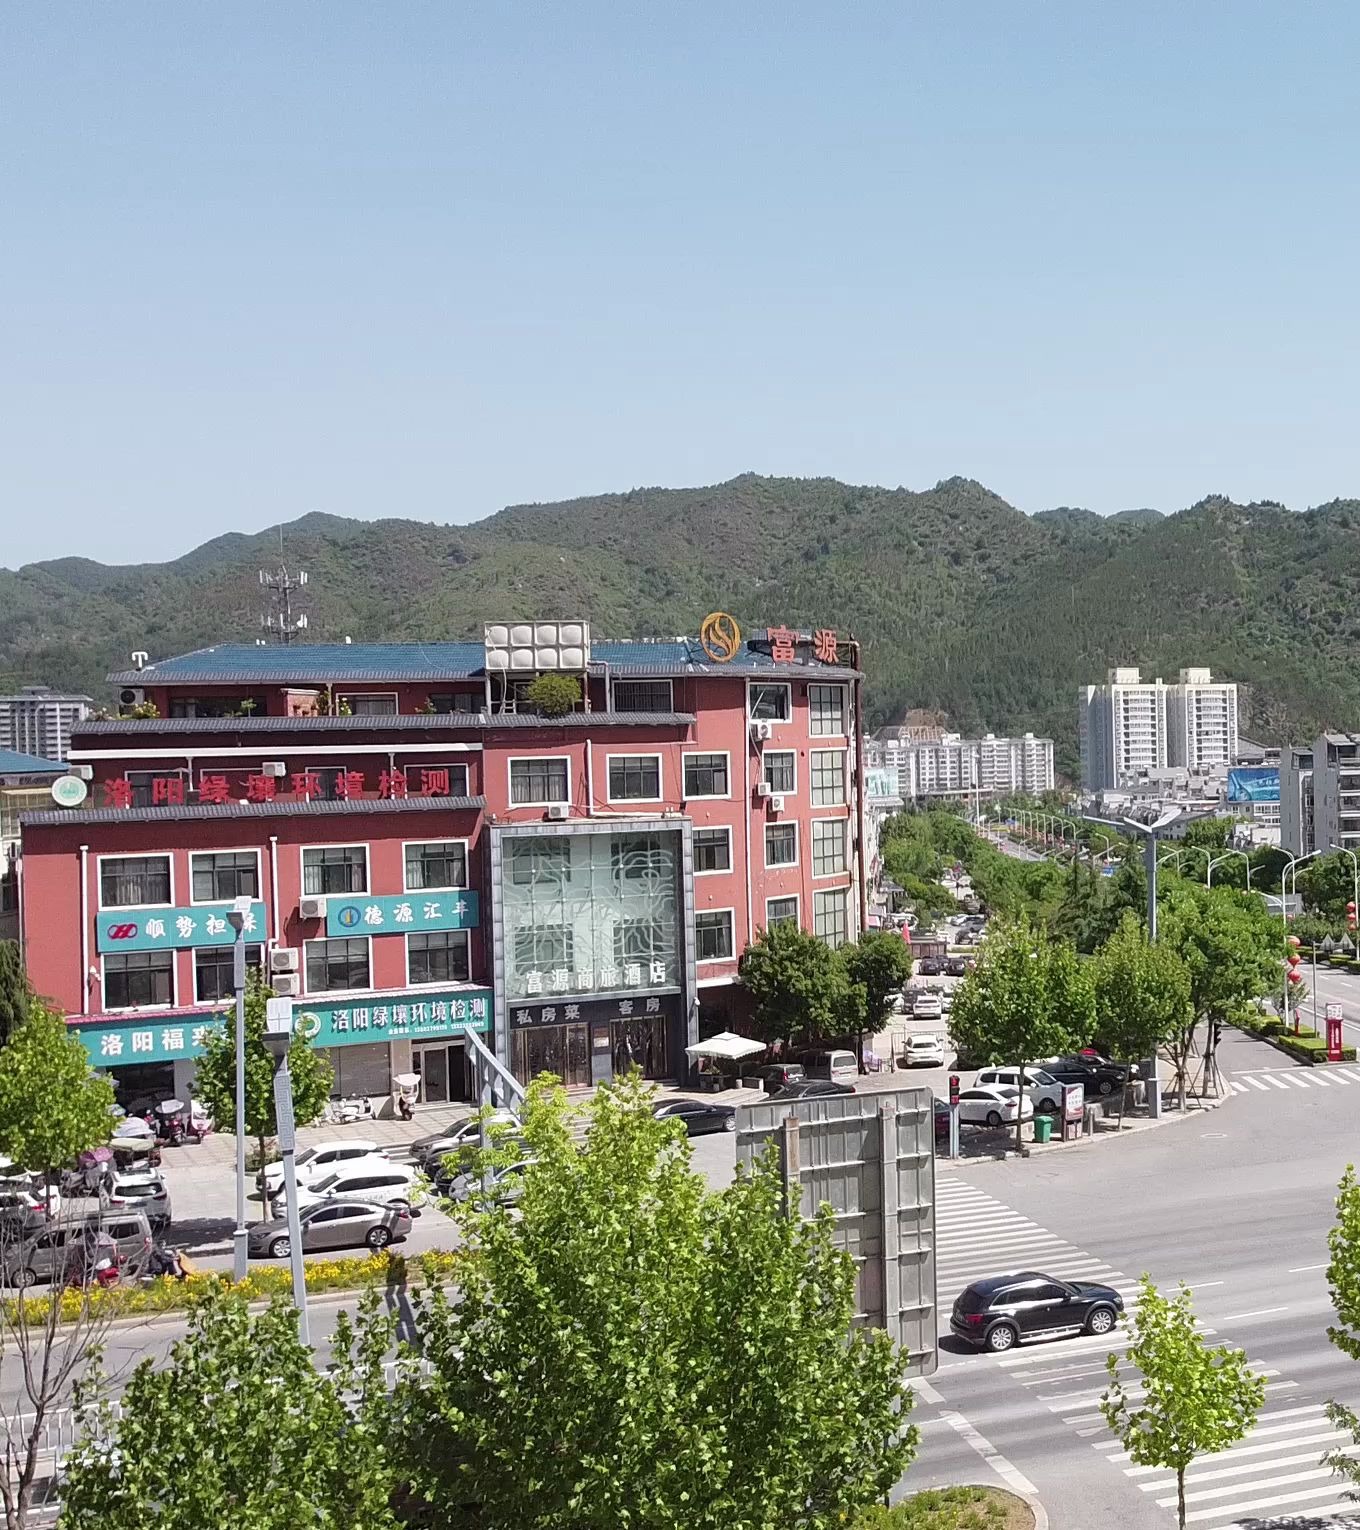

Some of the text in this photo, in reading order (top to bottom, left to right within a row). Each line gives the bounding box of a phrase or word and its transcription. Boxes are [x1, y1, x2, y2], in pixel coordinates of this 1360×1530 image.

[767, 624, 838, 663] 富源
[364, 899, 469, 924] 德源汇丰
[526, 961, 665, 993] 富源商旅酒店
[332, 998, 485, 1029] 洛阳绿壤环境检测
[516, 998, 660, 1025] 私房菜 客房
